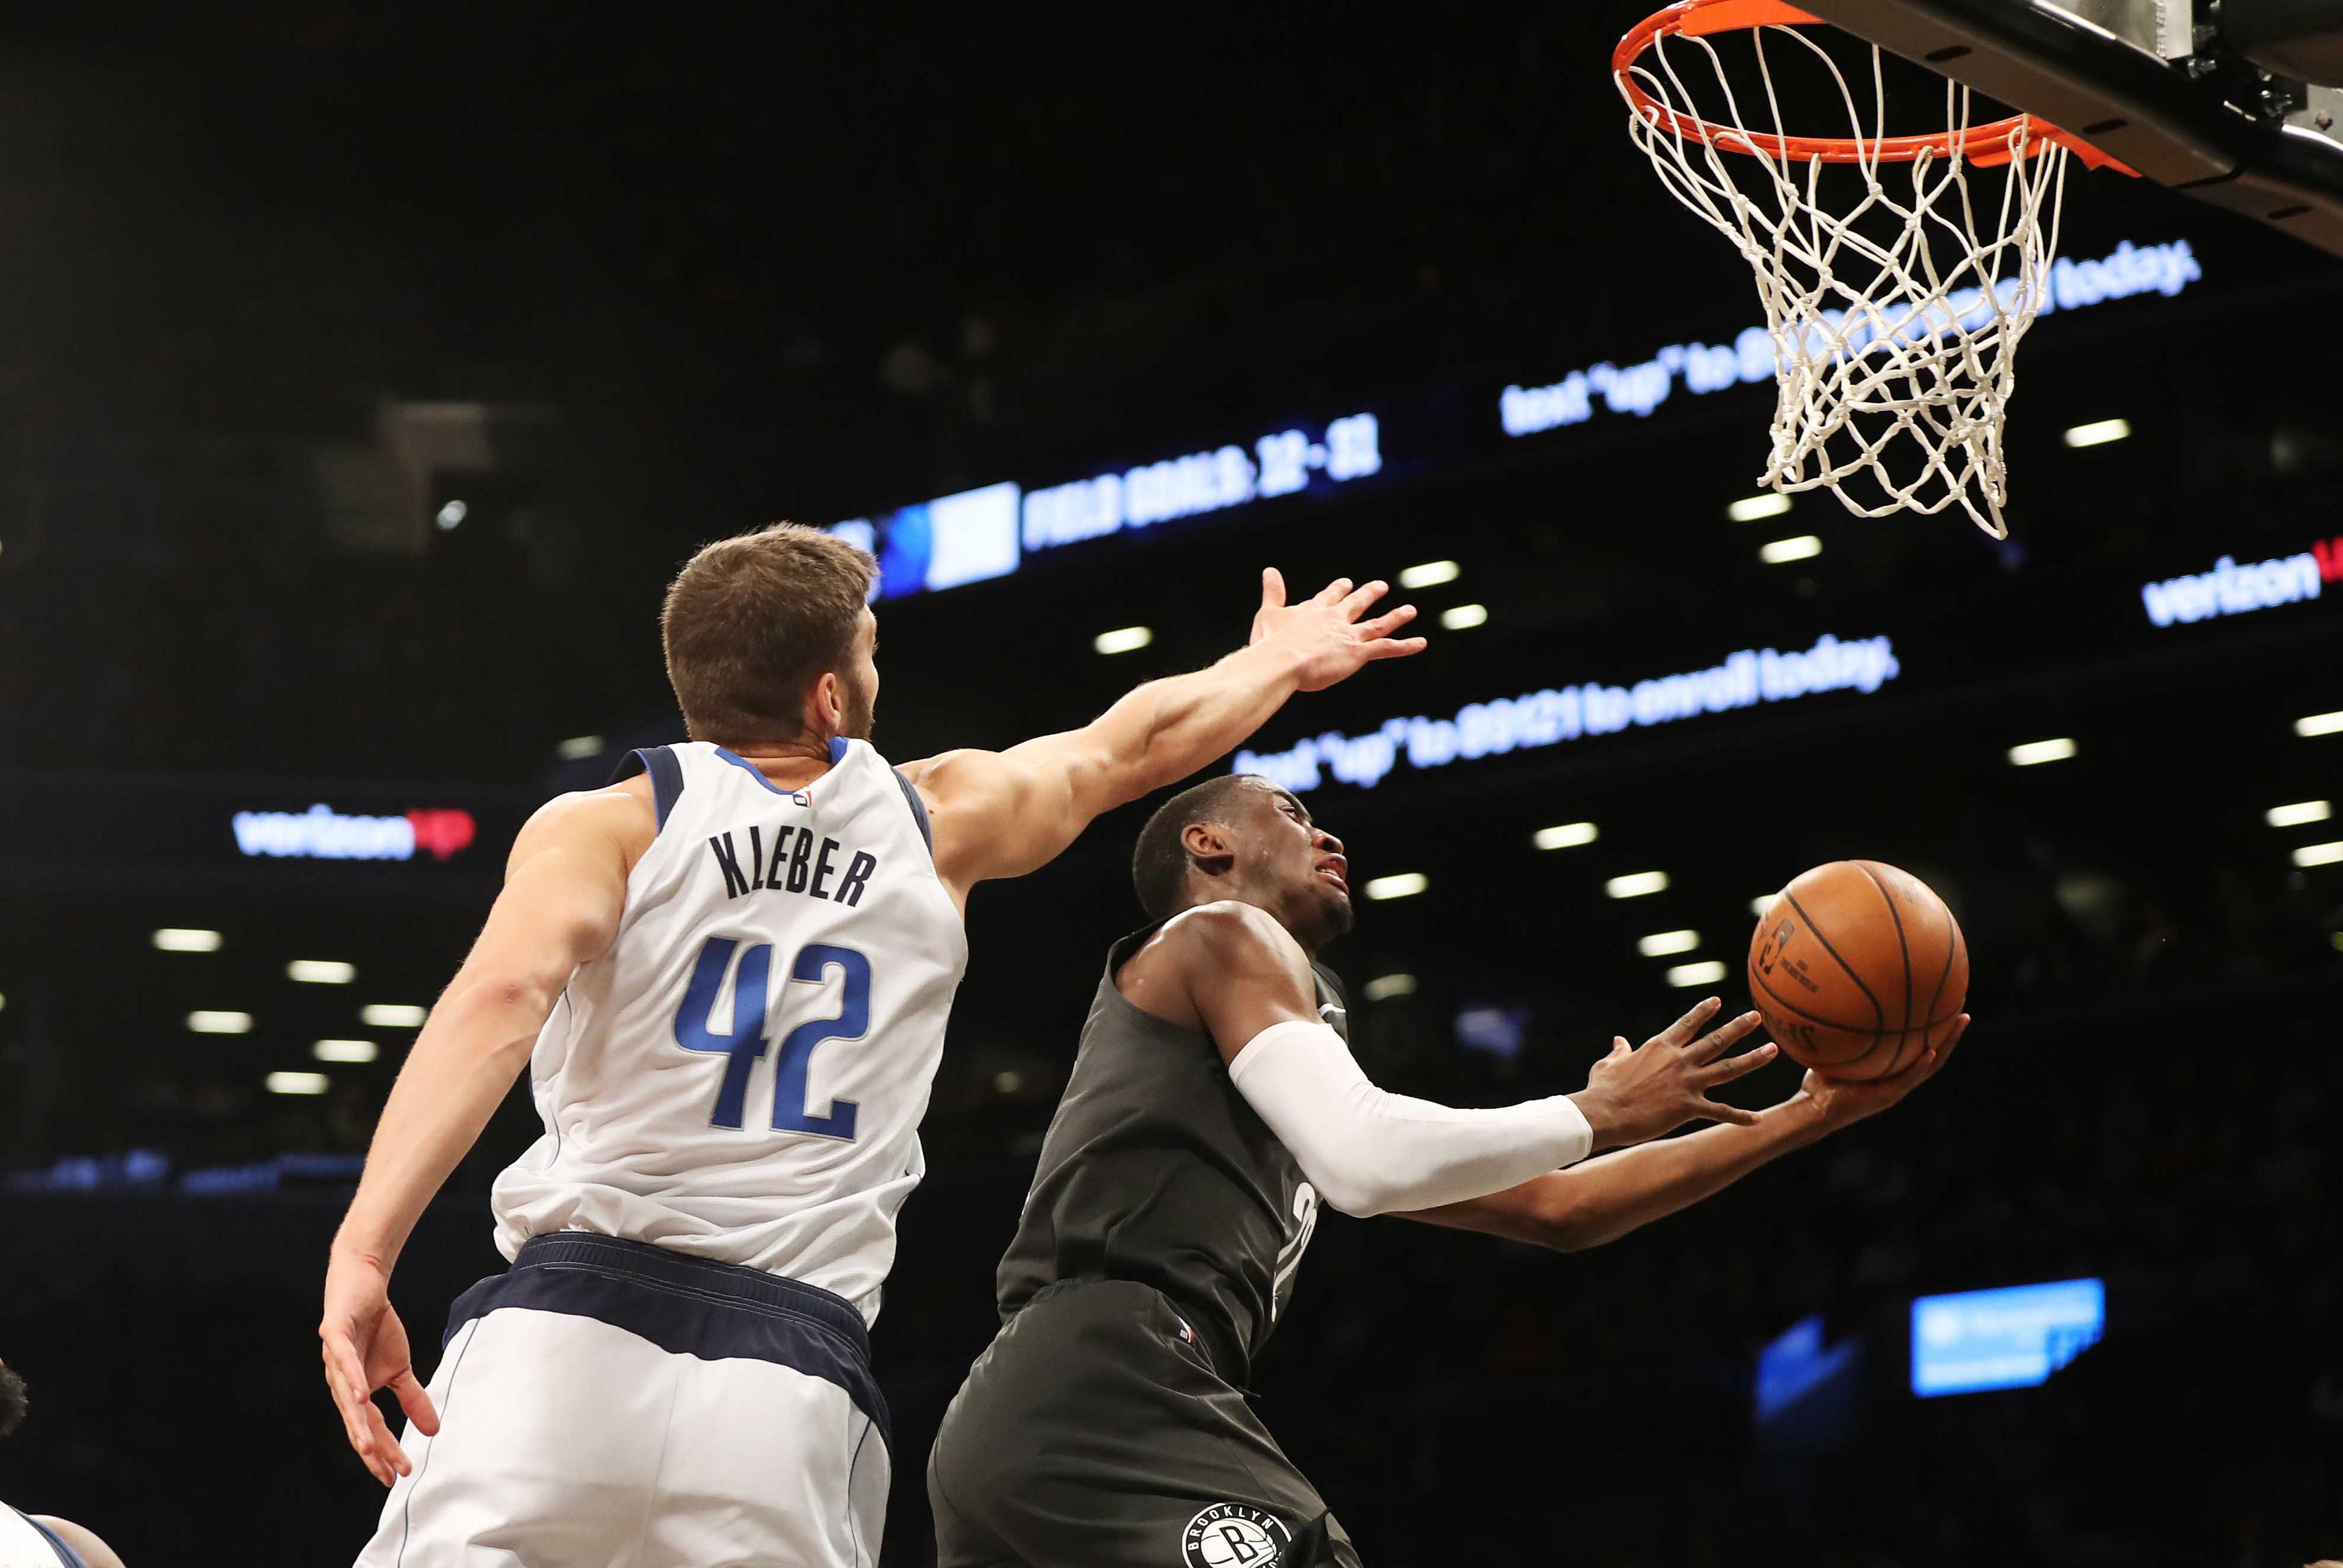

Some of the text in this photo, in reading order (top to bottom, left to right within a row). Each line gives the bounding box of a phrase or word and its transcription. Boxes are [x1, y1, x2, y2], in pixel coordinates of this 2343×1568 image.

[1502, 371, 1590, 434] text
[1686, 343, 1736, 392] to
[1023, 474, 1124, 548] FIELD
[2142, 552, 2320, 627] verizon
[1407, 717, 1457, 766] to
[1582, 683, 1632, 733] to
[1630, 649, 1758, 724] enroll
[1760, 634, 1899, 700] today.
[231, 804, 416, 861] verizon
[709, 825, 877, 907] KLEBER
[673, 936, 873, 1143] 42
[1187, 1505, 1275, 1551] BROOKLYN
[1220, 1526, 1259, 1565] B
